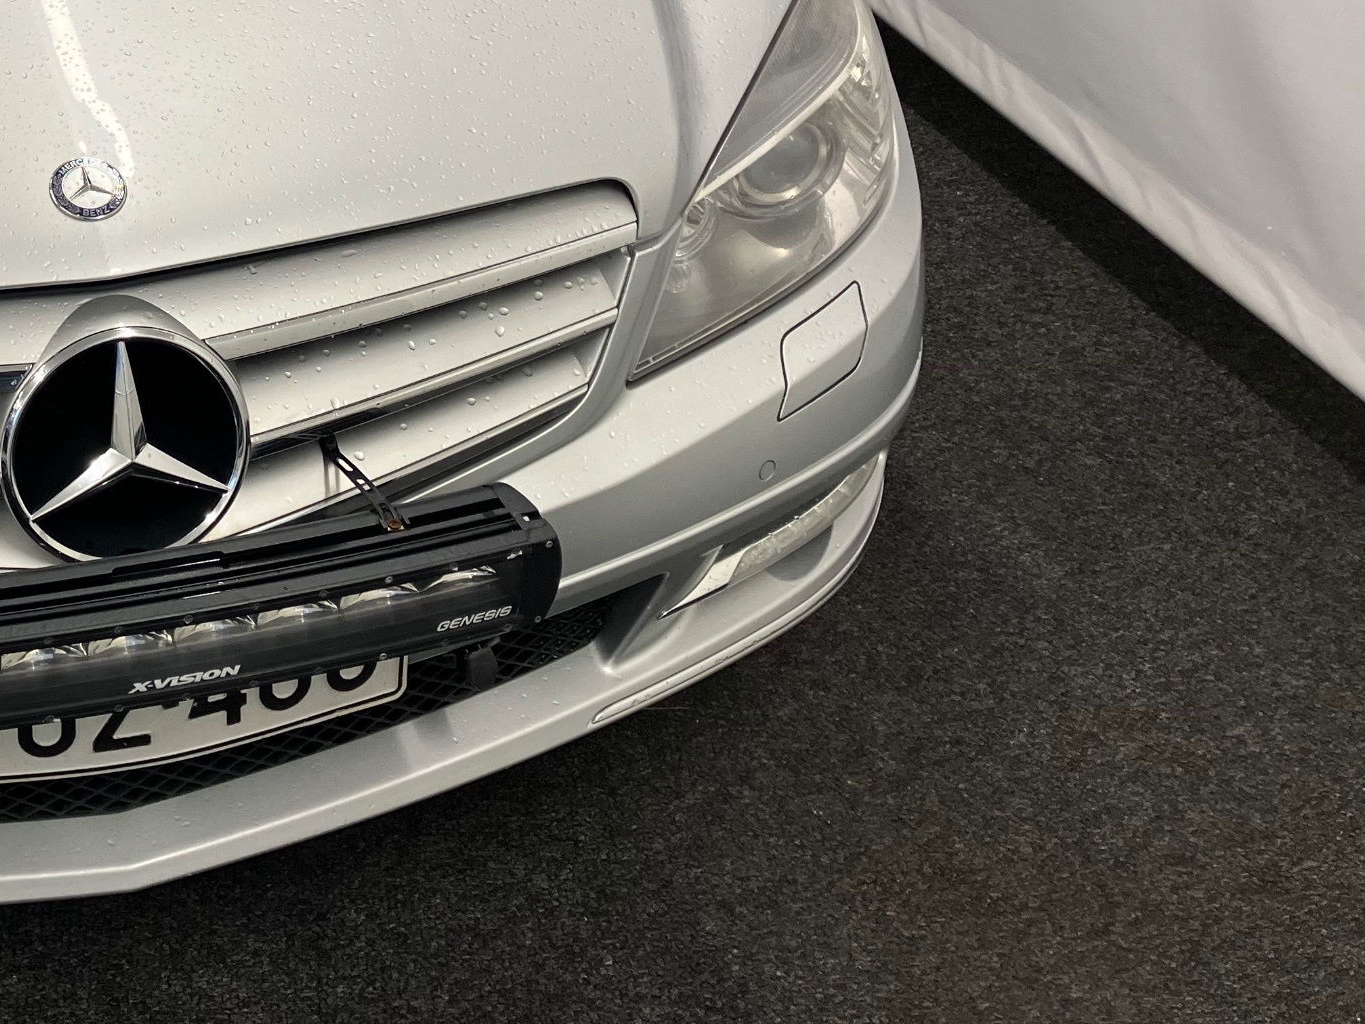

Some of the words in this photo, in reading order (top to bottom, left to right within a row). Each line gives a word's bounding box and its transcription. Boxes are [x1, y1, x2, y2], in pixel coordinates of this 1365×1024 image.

[82, 205, 111, 217] BENZ
[437, 605, 513, 632] GENESIS
[127, 664, 241, 695] X-VISION
